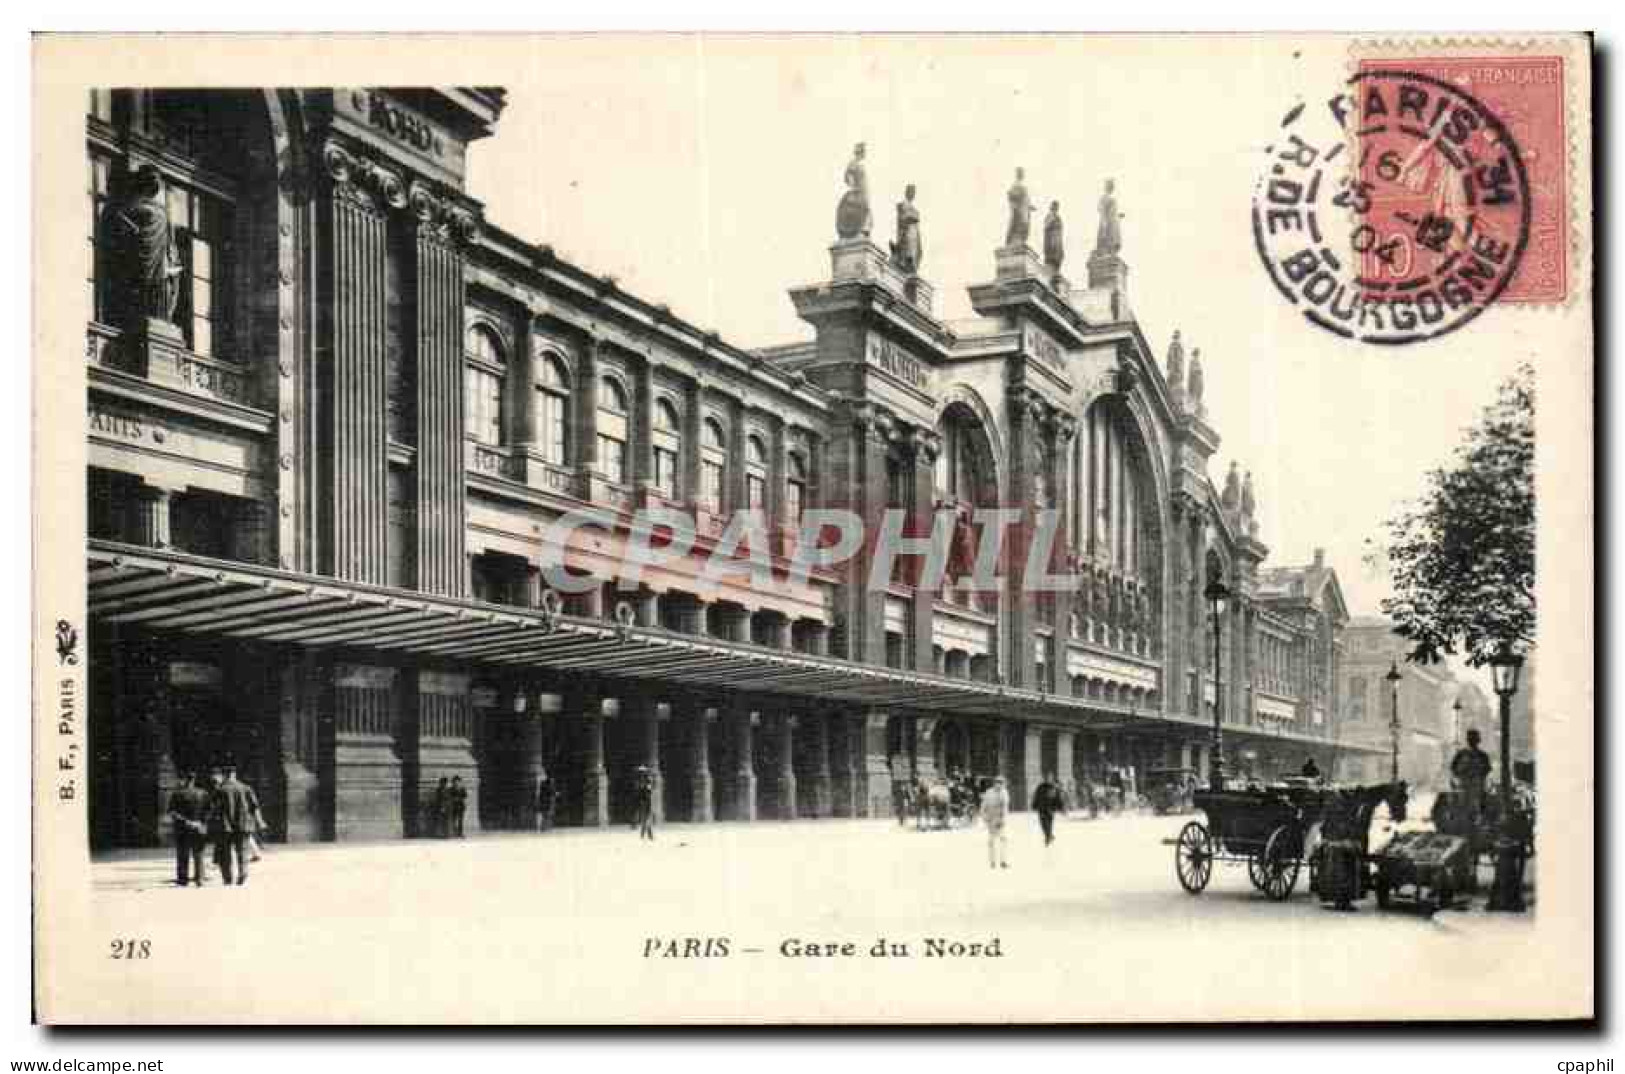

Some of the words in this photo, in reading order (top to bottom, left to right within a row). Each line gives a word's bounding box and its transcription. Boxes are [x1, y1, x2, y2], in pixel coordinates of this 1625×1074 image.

[1329, 86, 1480, 144] PARIS
[1281, 234, 1510, 330] BOURGOGNE
[59, 678, 74, 736] PARIS
[60, 779, 74, 800] B.
[110, 940, 152, 960] 218
[643, 938, 730, 958] PARIS
[780, 938, 856, 958] Gare
[869, 938, 908, 958] du
[923, 938, 1003, 958] Nord
